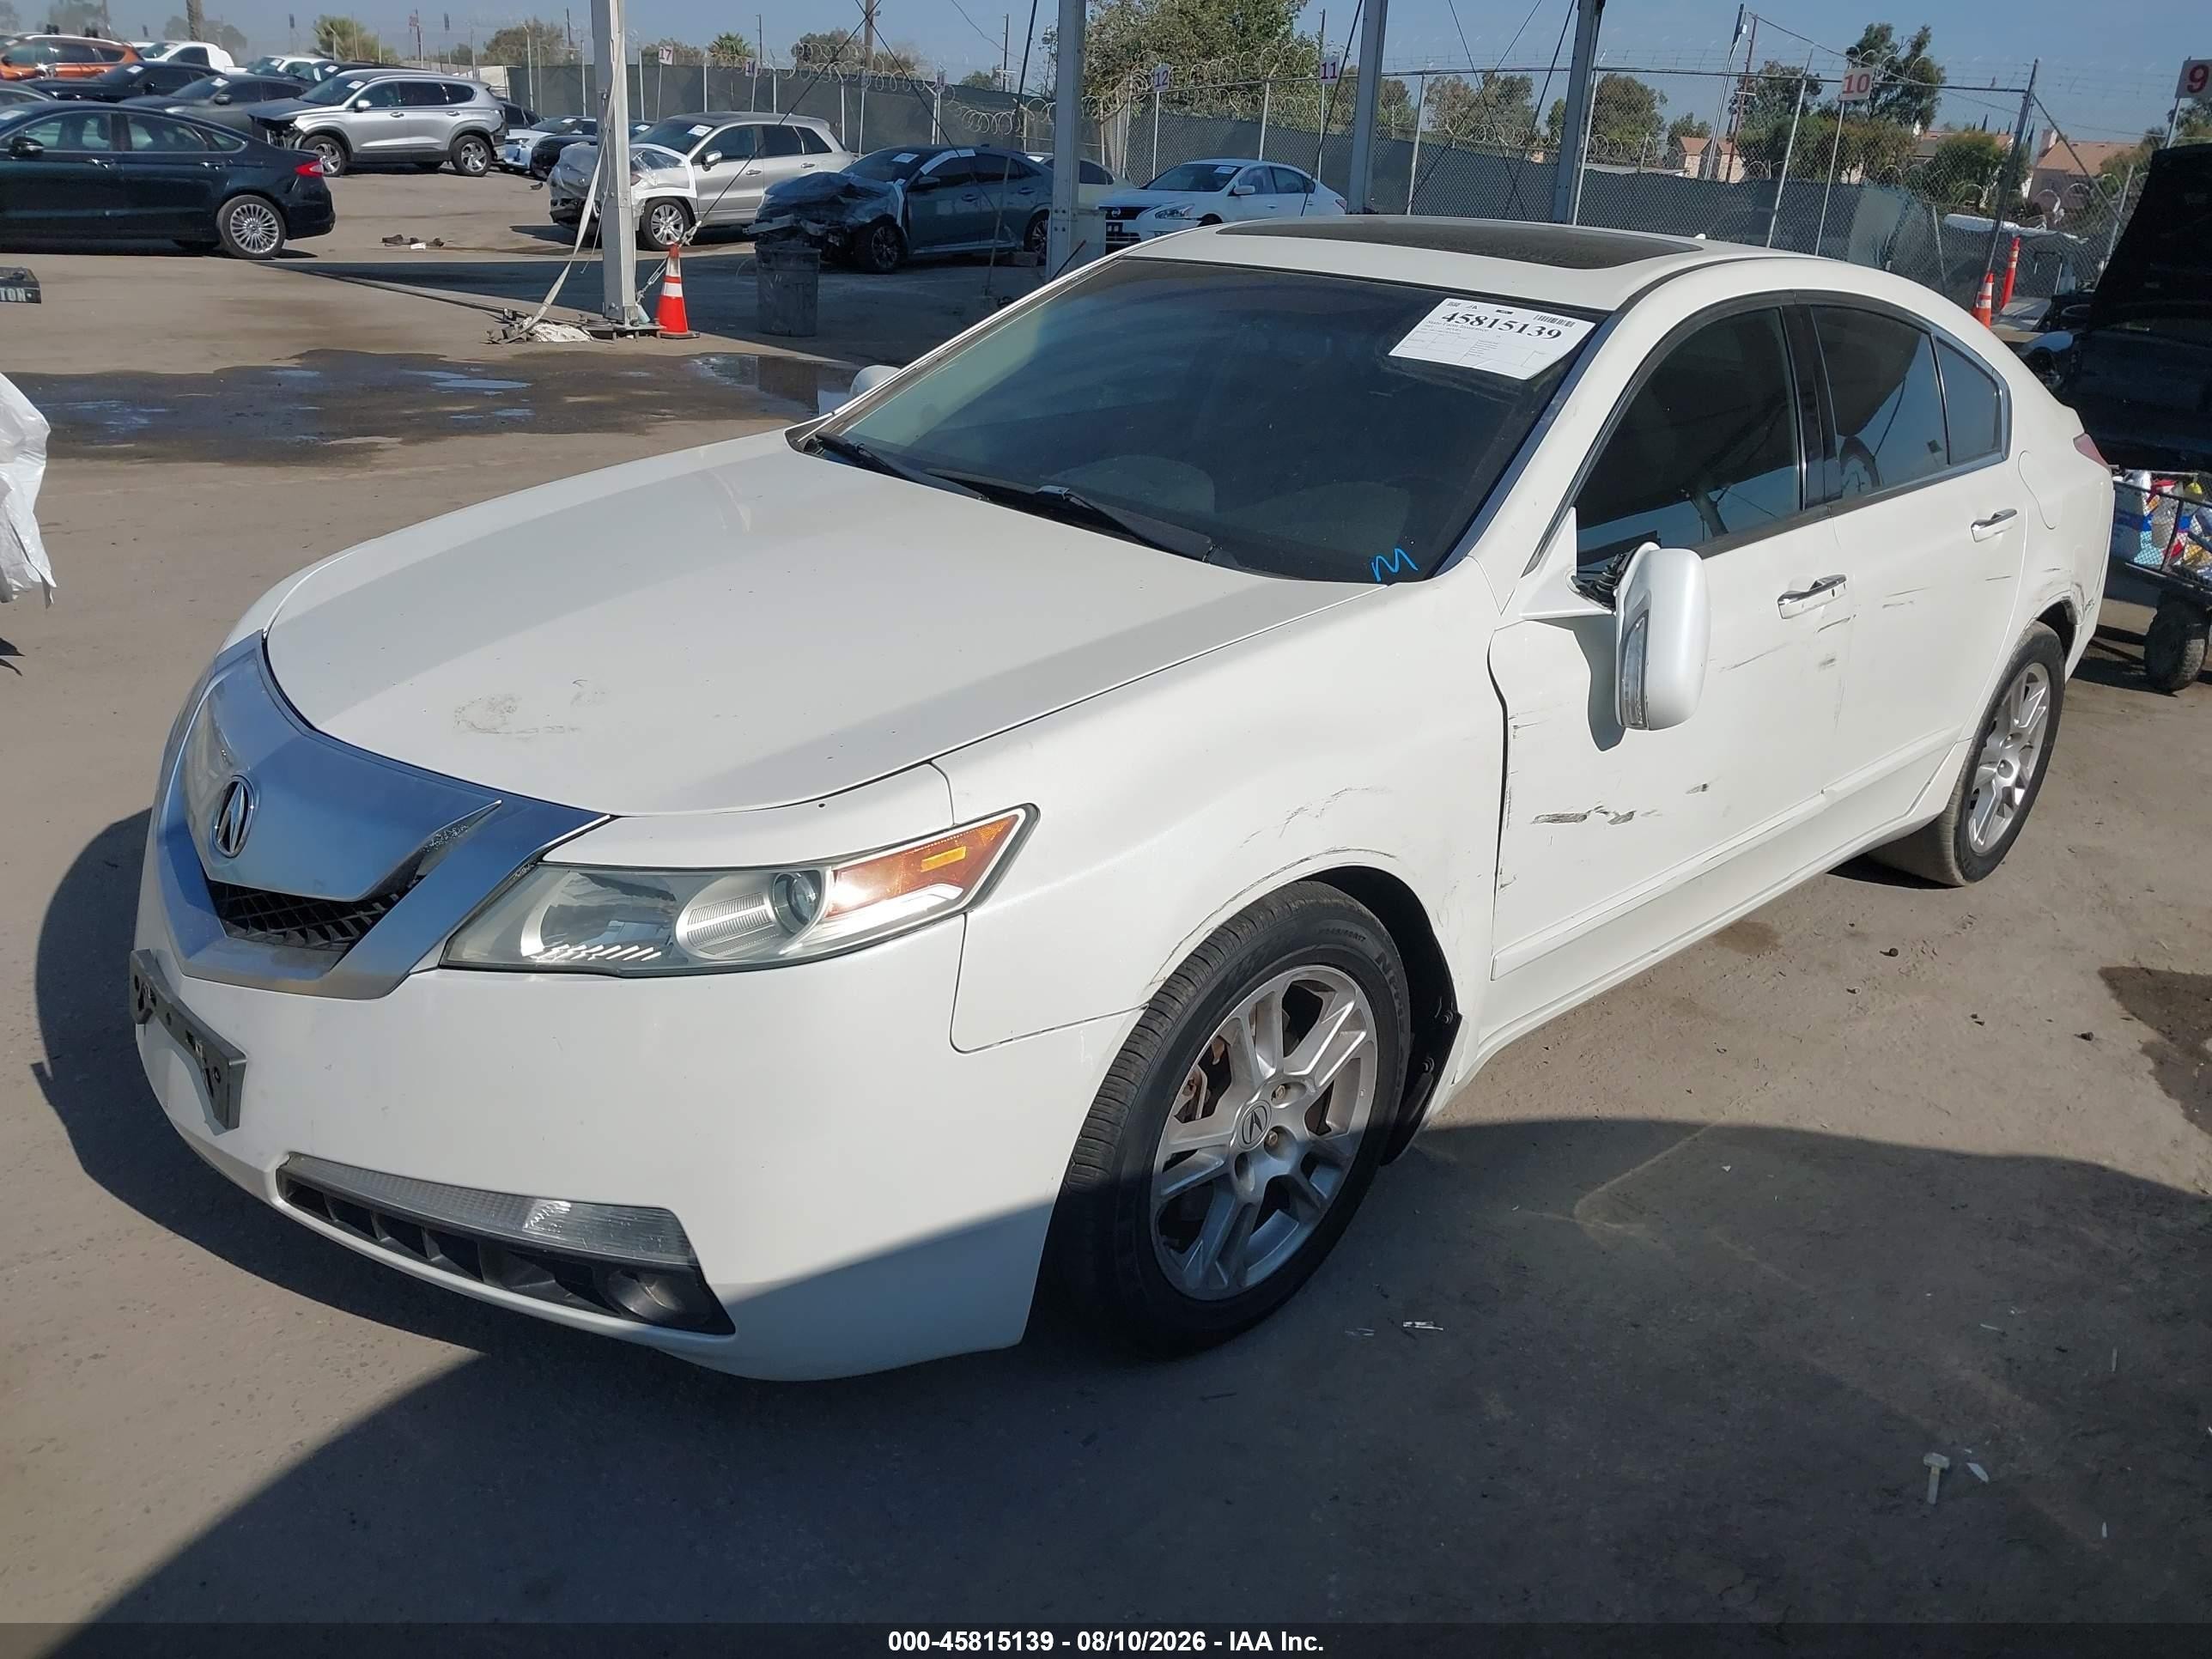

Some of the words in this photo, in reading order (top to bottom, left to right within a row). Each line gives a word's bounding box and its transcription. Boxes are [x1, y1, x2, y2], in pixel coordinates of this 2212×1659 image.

[659, 48, 672, 61] 17
[1155, 70, 1169, 87] 12
[1321, 62, 1338, 79] 11
[2187, 64, 2209, 93] 9
[1842, 74, 1870, 94] 10
[1442, 312, 1562, 339] 45815139
[1370, 548, 1419, 582] M
